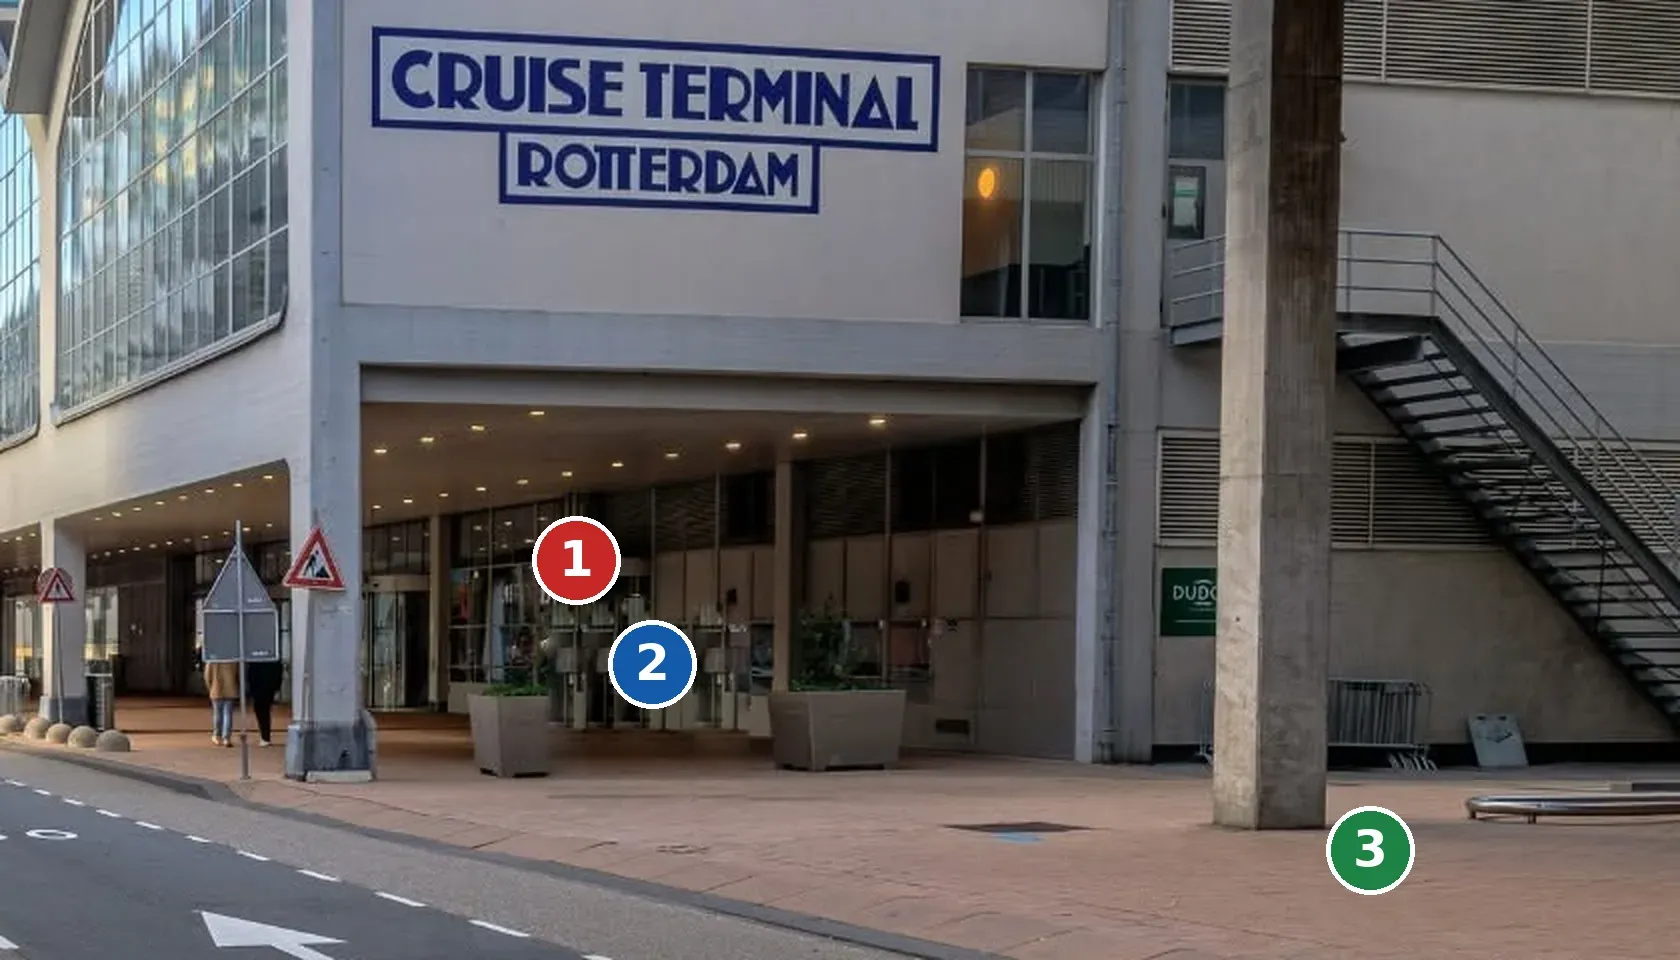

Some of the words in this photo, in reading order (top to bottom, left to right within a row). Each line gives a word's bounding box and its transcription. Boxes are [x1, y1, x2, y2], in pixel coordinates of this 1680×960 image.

[391, 49, 624, 118] CRUISE
[639, 62, 919, 131] TERMINAL
[516, 141, 799, 198] ROTTERDAM
